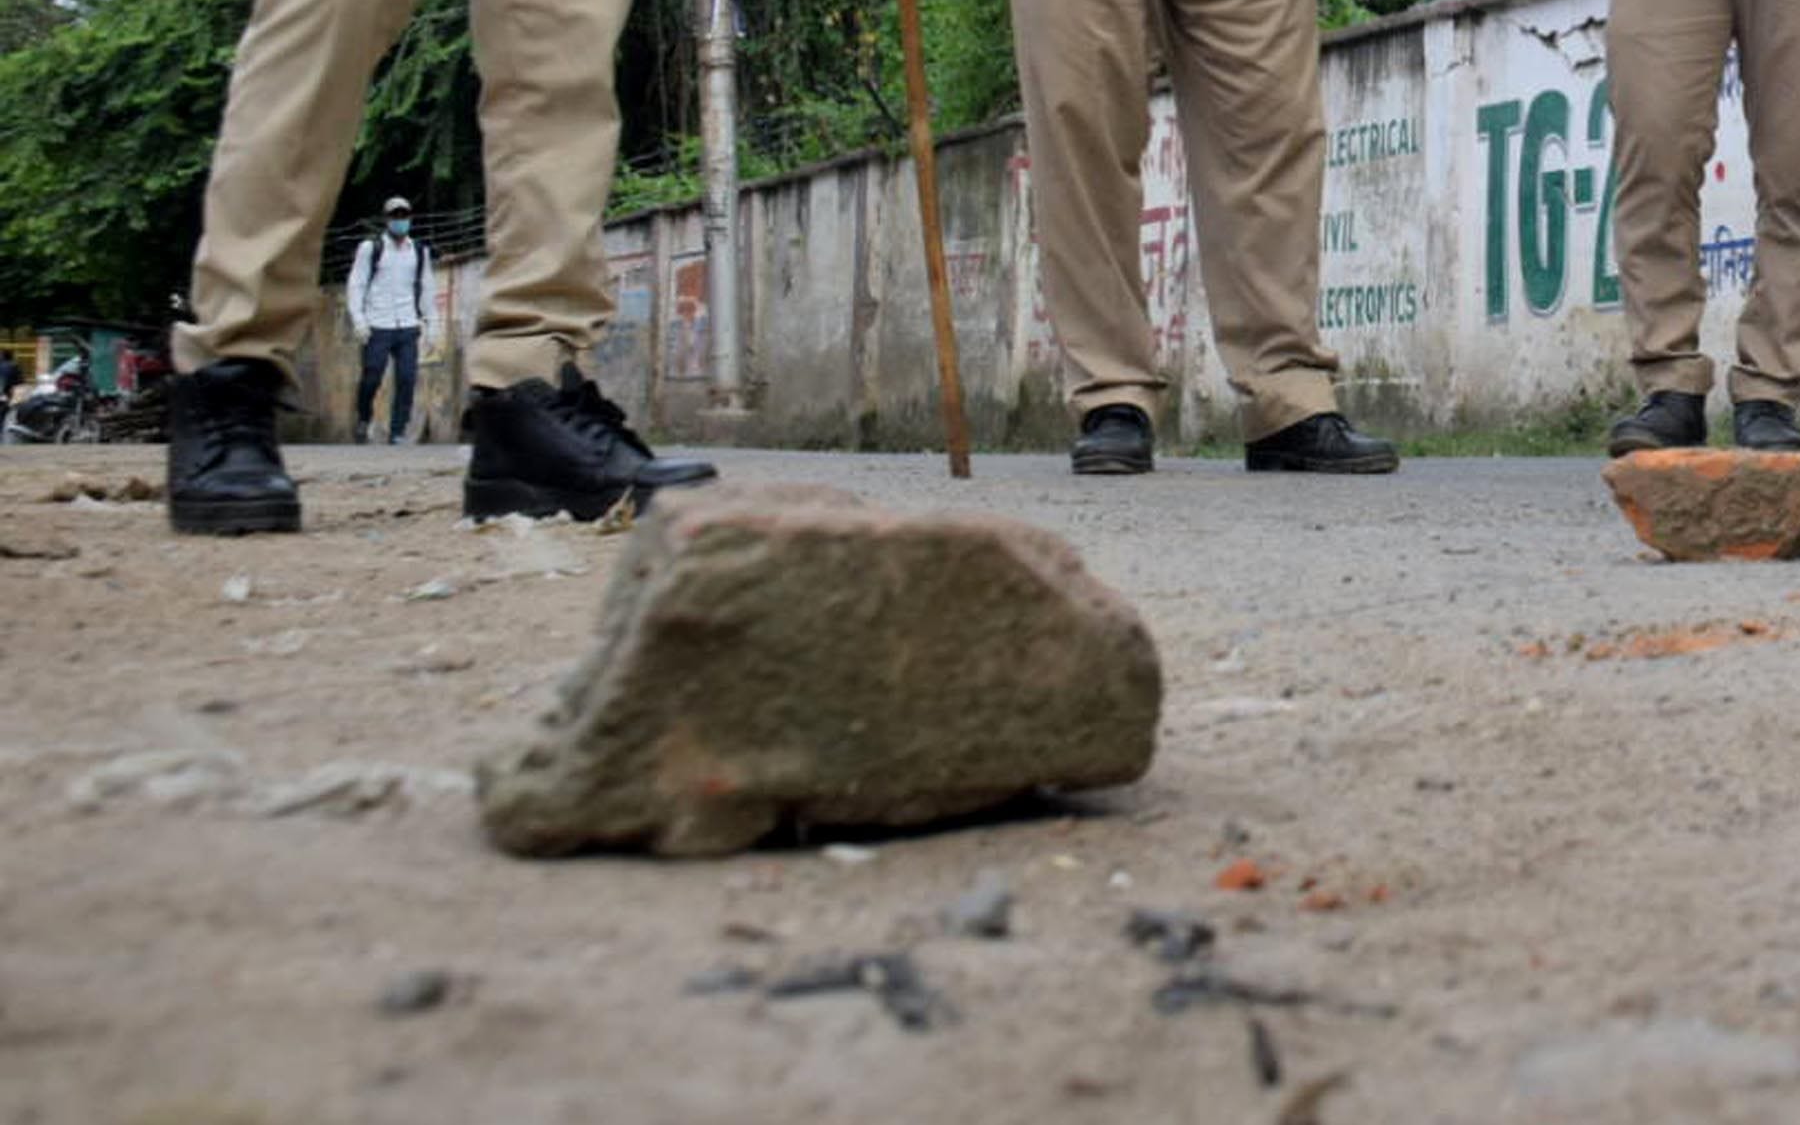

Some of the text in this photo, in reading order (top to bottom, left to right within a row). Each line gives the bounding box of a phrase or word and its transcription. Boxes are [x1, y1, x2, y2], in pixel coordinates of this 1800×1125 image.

[1327, 116, 1420, 167] LECTRICAL
[1323, 211, 1359, 253] IVIL
[1317, 283, 1417, 331] LECTRONICS
